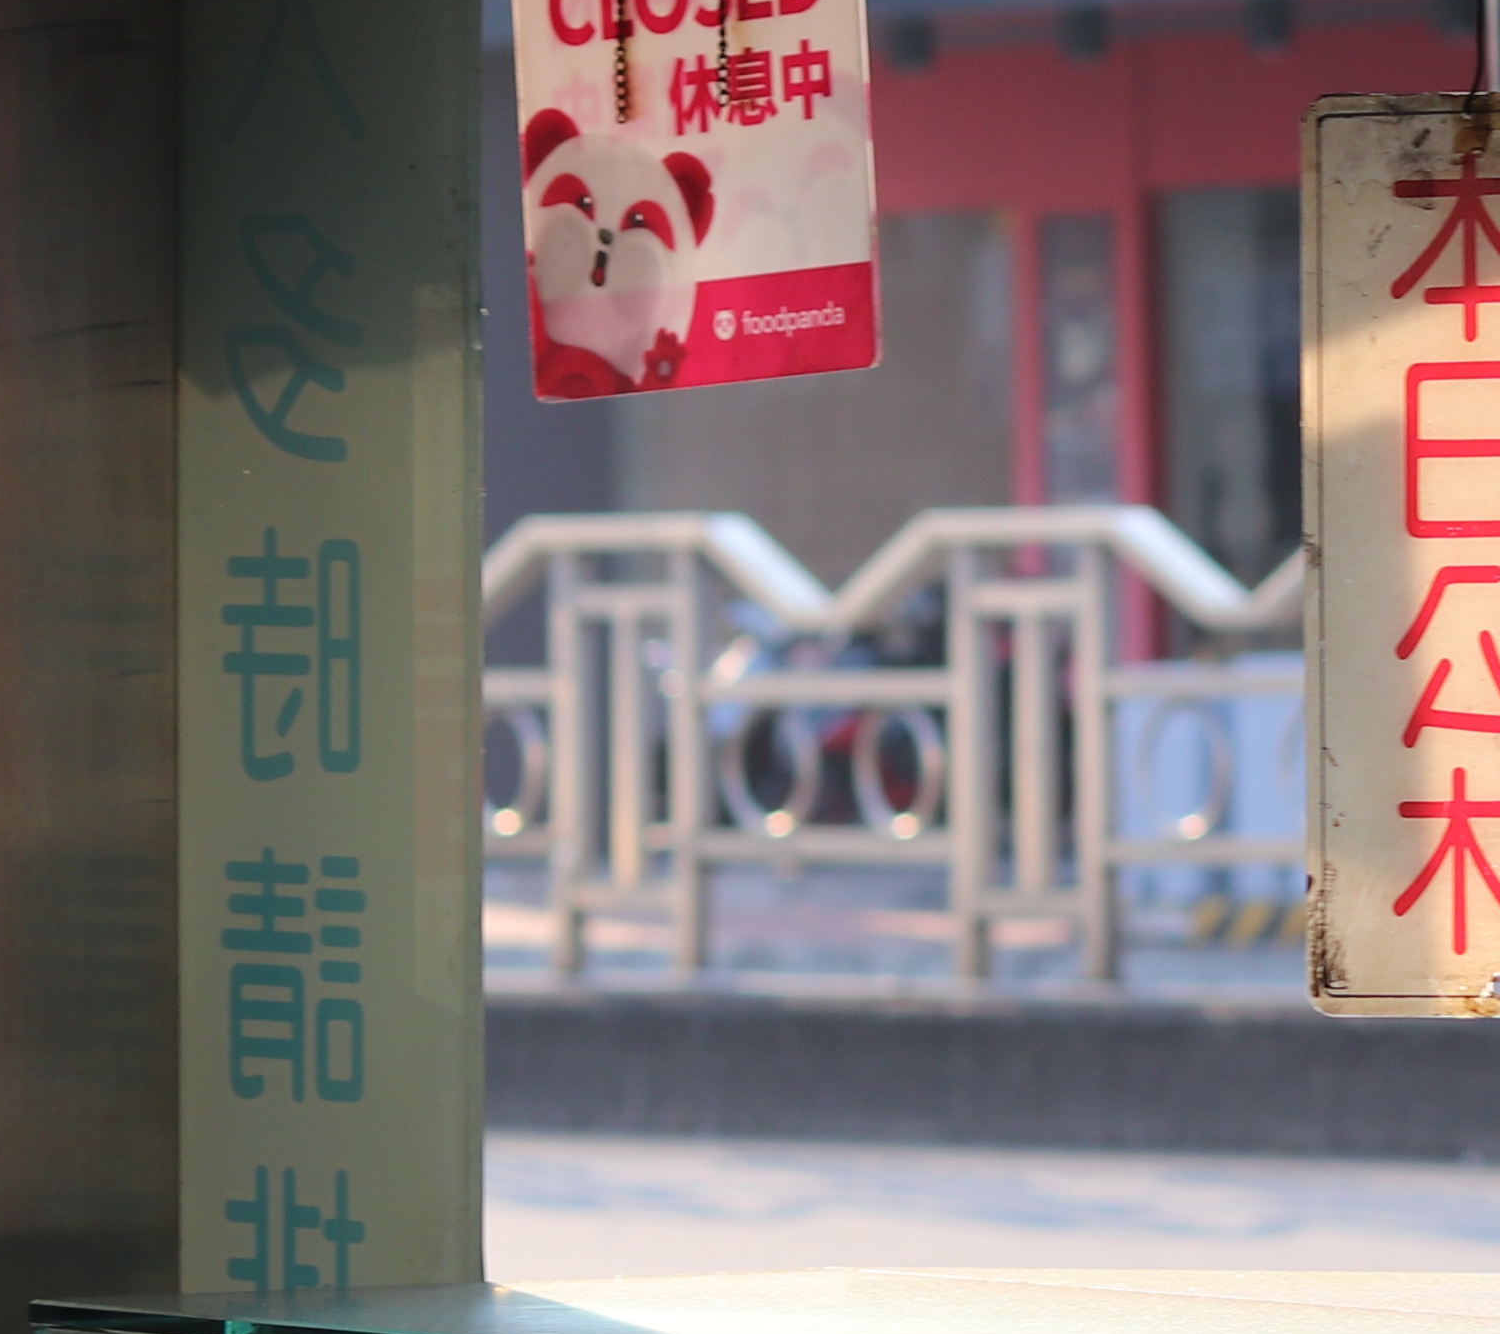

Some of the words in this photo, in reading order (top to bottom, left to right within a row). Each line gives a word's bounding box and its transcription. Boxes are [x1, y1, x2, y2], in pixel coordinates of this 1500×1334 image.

[669, 38, 833, 136] 休息中
[741, 300, 846, 340] foodpanda
